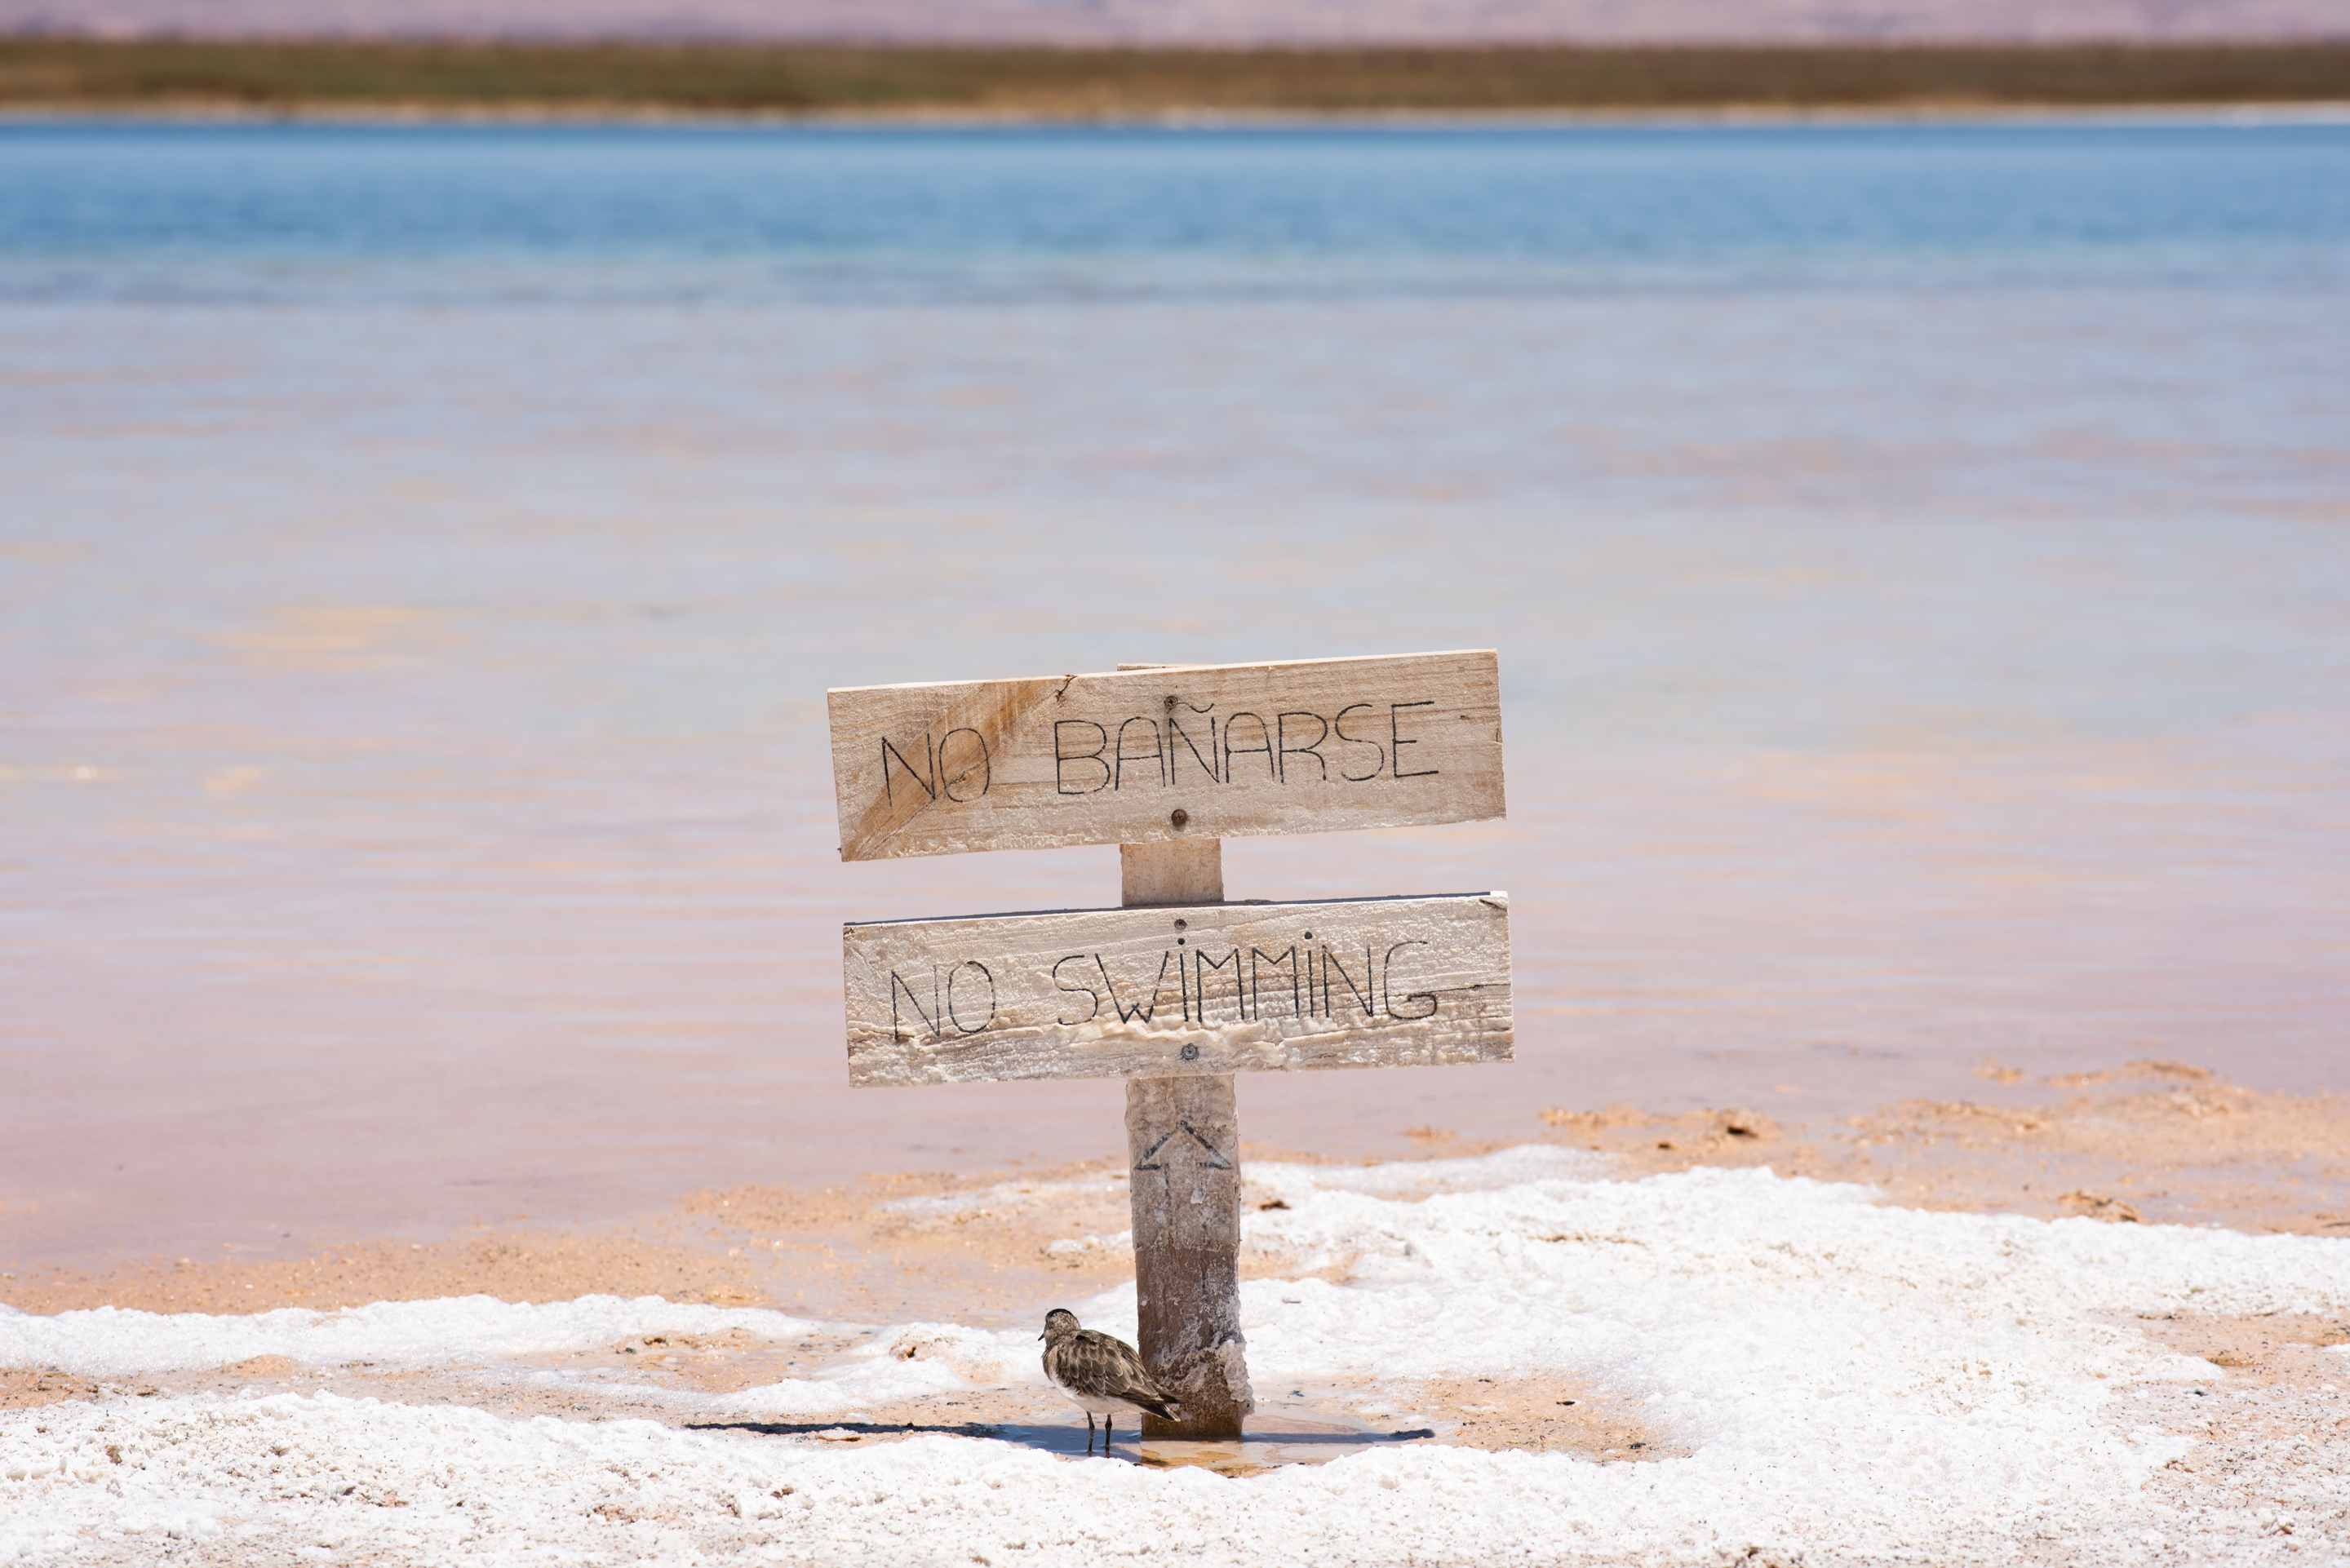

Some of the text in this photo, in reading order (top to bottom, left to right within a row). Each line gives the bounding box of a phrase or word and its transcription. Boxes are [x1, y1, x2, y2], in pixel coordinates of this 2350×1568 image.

[880, 701, 1439, 808] NO BAÑARSE
[889, 960, 997, 1040] NO
